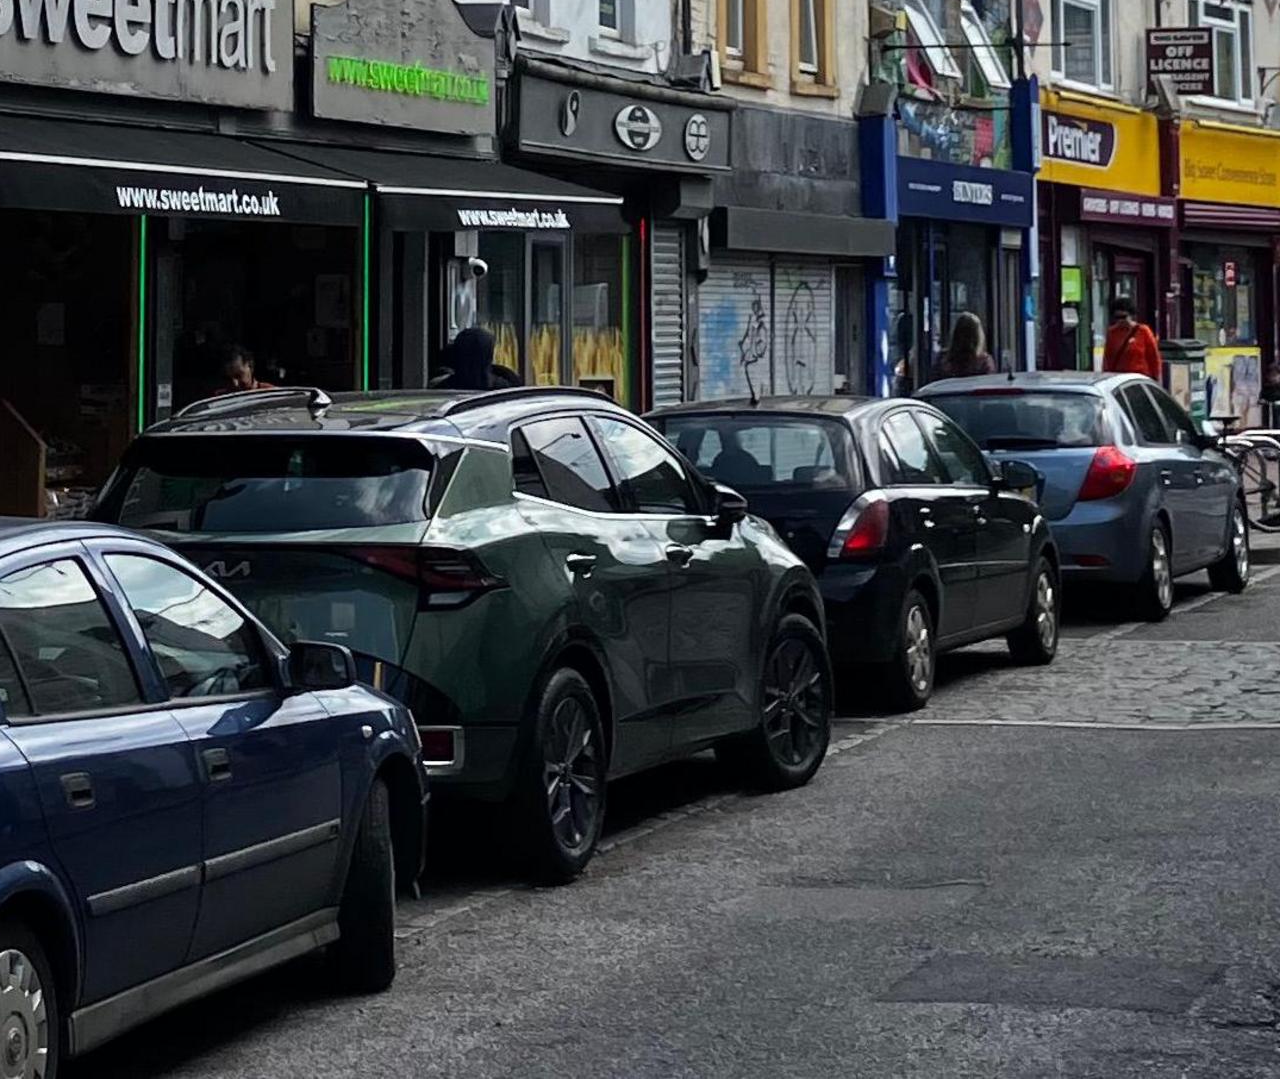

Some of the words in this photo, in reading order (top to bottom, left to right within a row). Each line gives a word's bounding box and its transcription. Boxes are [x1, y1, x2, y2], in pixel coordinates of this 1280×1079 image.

[1165, 45, 1194, 58] OFF
[1150, 58, 1210, 71] LICENCE
[1047, 115, 1102, 163] Premier
[116, 186, 280, 216] www.sweetmart.co.uk
